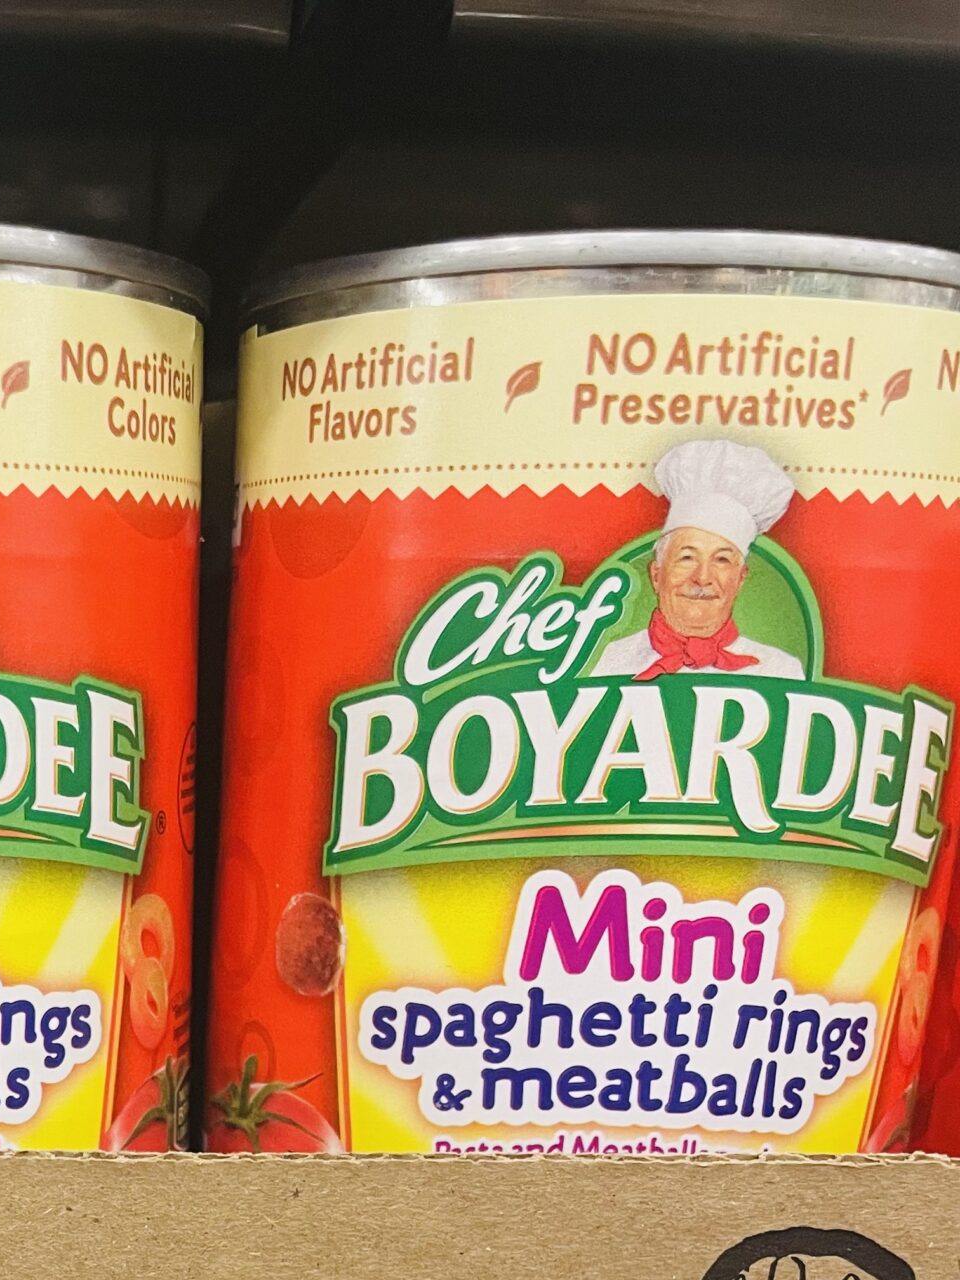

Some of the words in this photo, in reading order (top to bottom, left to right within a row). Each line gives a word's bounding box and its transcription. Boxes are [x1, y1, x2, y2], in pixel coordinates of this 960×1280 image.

[61, 340, 109, 385] NO
[115, 346, 195, 405] Artificial
[282, 359, 314, 401] NO
[321, 337, 474, 394] Artificial
[587, 333, 655, 375] NO
[665, 332, 854, 381] Artificial
[938, 348, 960, 392] N
[107, 397, 177, 447] Colors
[308, 399, 418, 443] Flavors
[406, 565, 622, 686] Chef
[334, 686, 948, 862] BOYARDEE
[518, 885, 770, 983] Mini
[371, 985, 718, 1064] spaghetti
[737, 992, 868, 1079] rings
